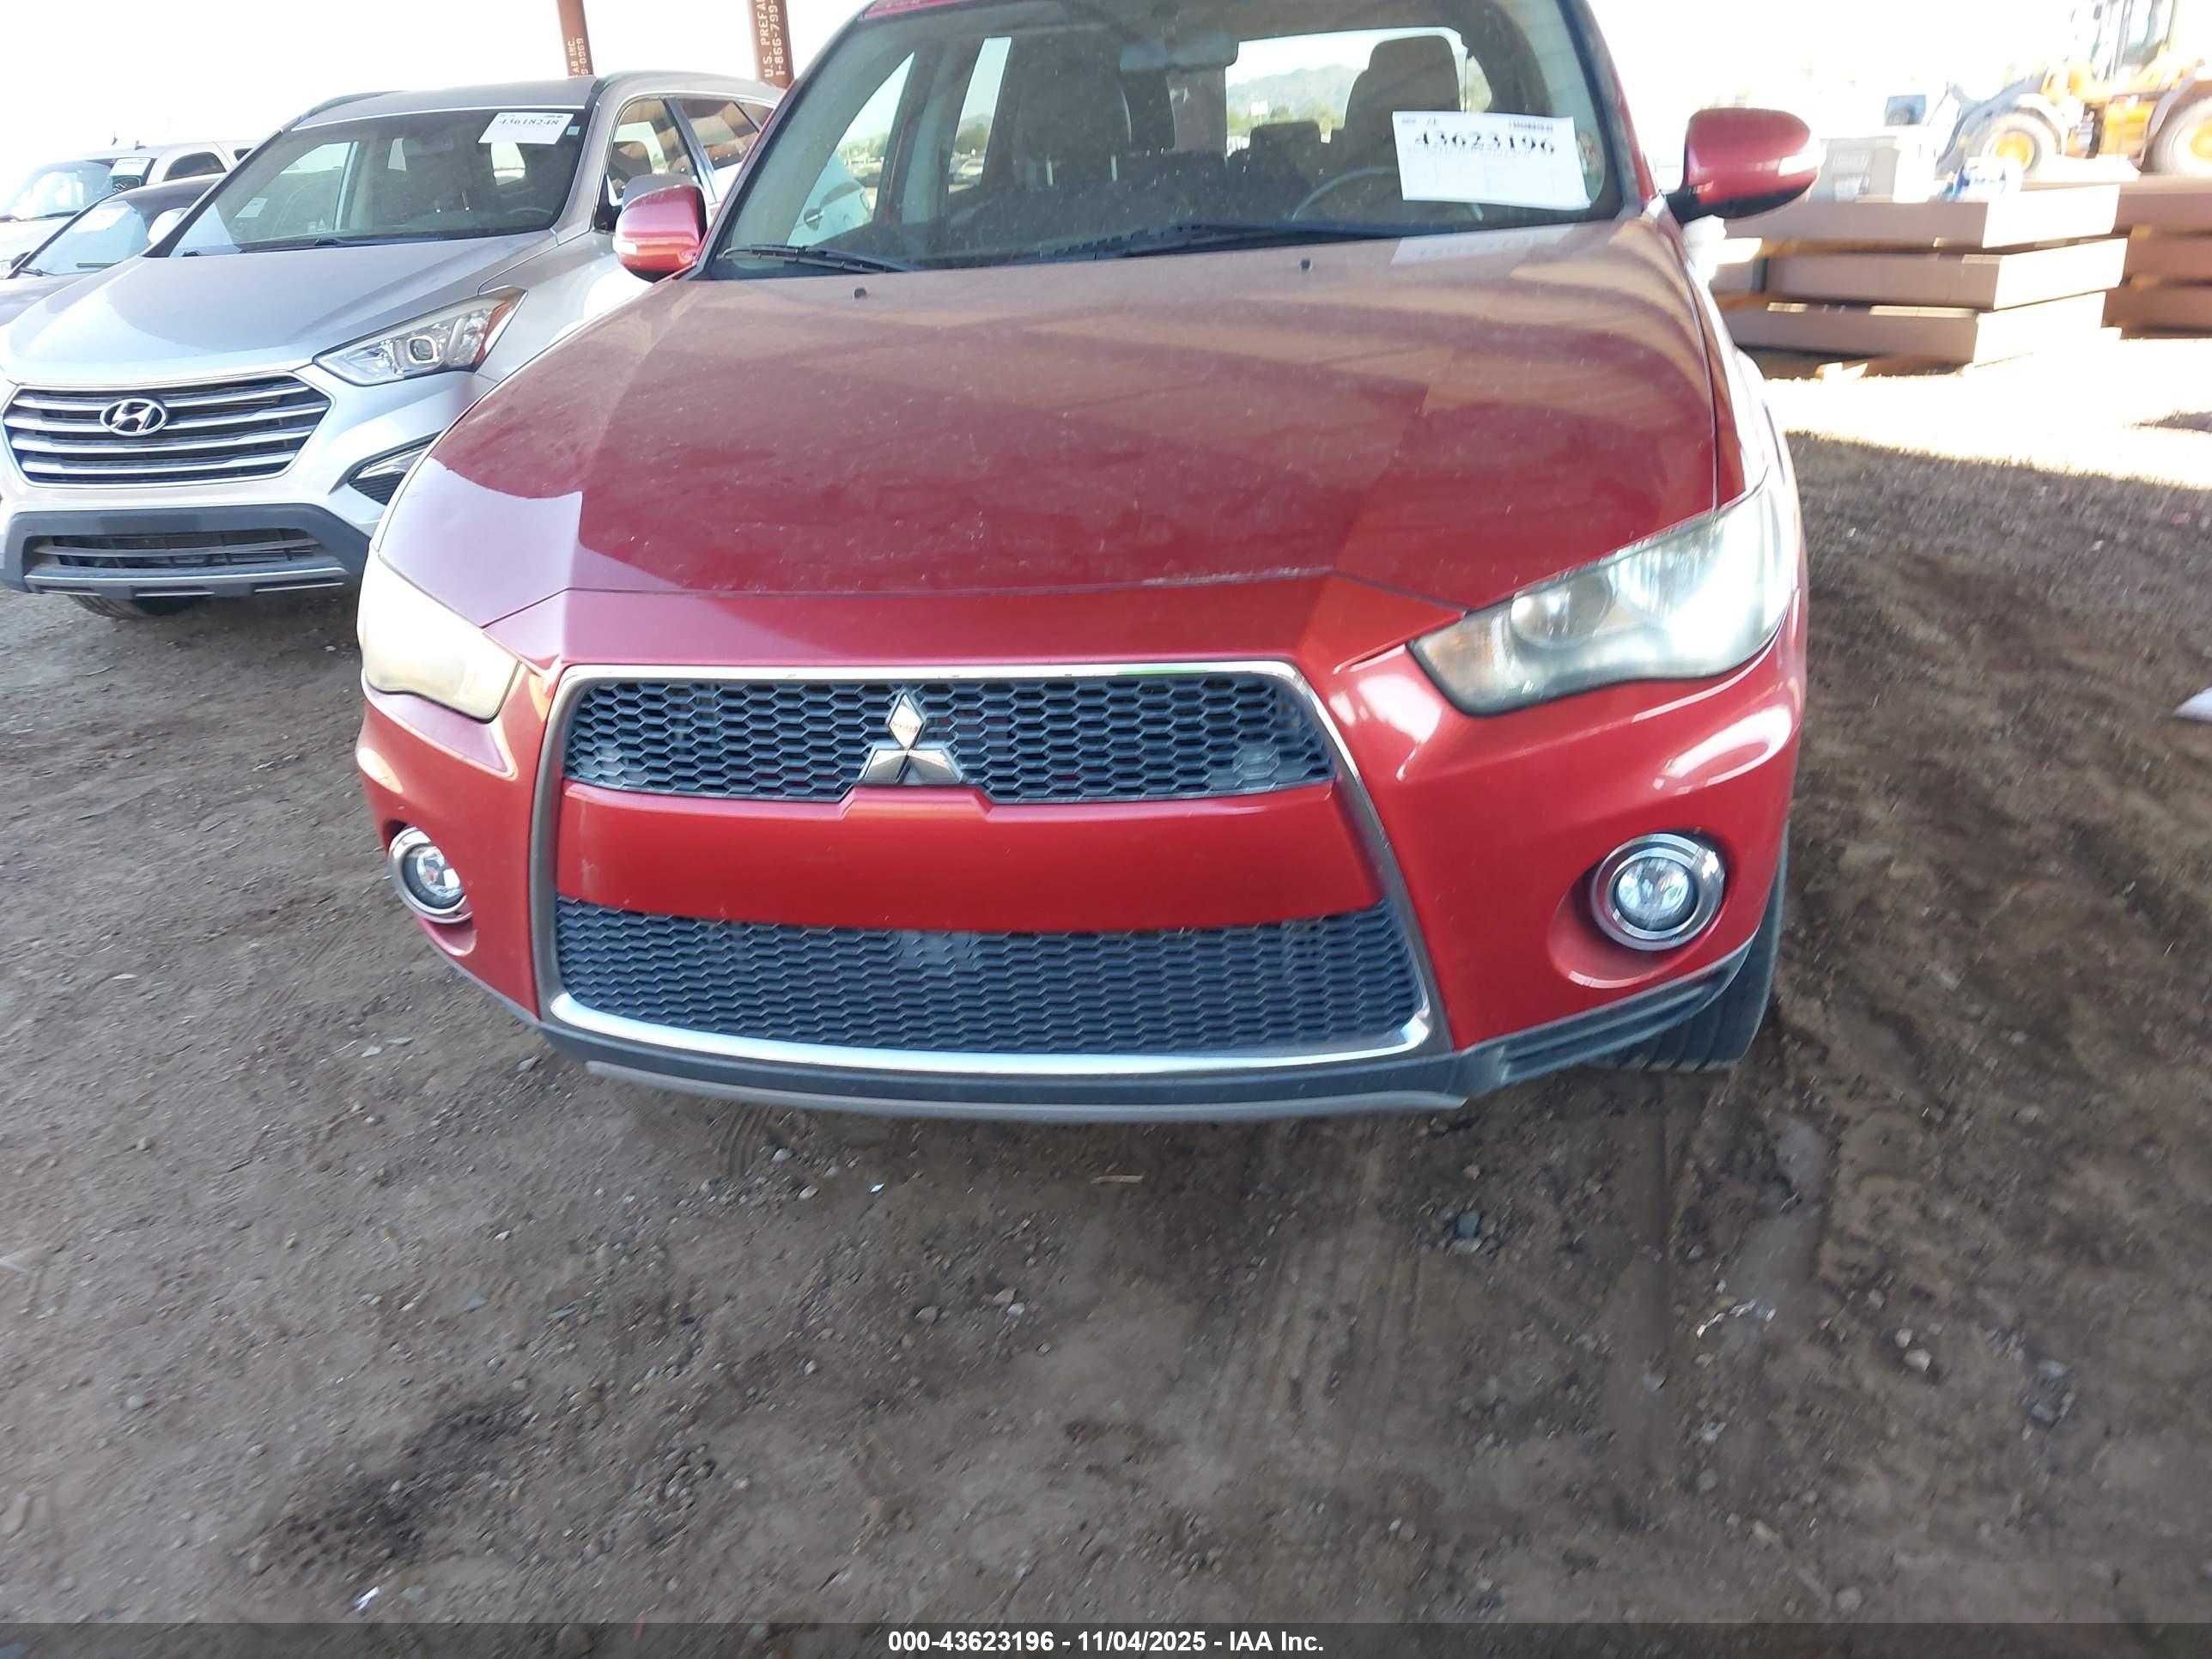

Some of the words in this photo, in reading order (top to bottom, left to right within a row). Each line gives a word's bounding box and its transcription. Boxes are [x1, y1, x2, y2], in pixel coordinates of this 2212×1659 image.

[756, 0, 770, 46] PREFA
[763, 52, 775, 78] U.S.
[1415, 130, 1555, 156] 43623196
